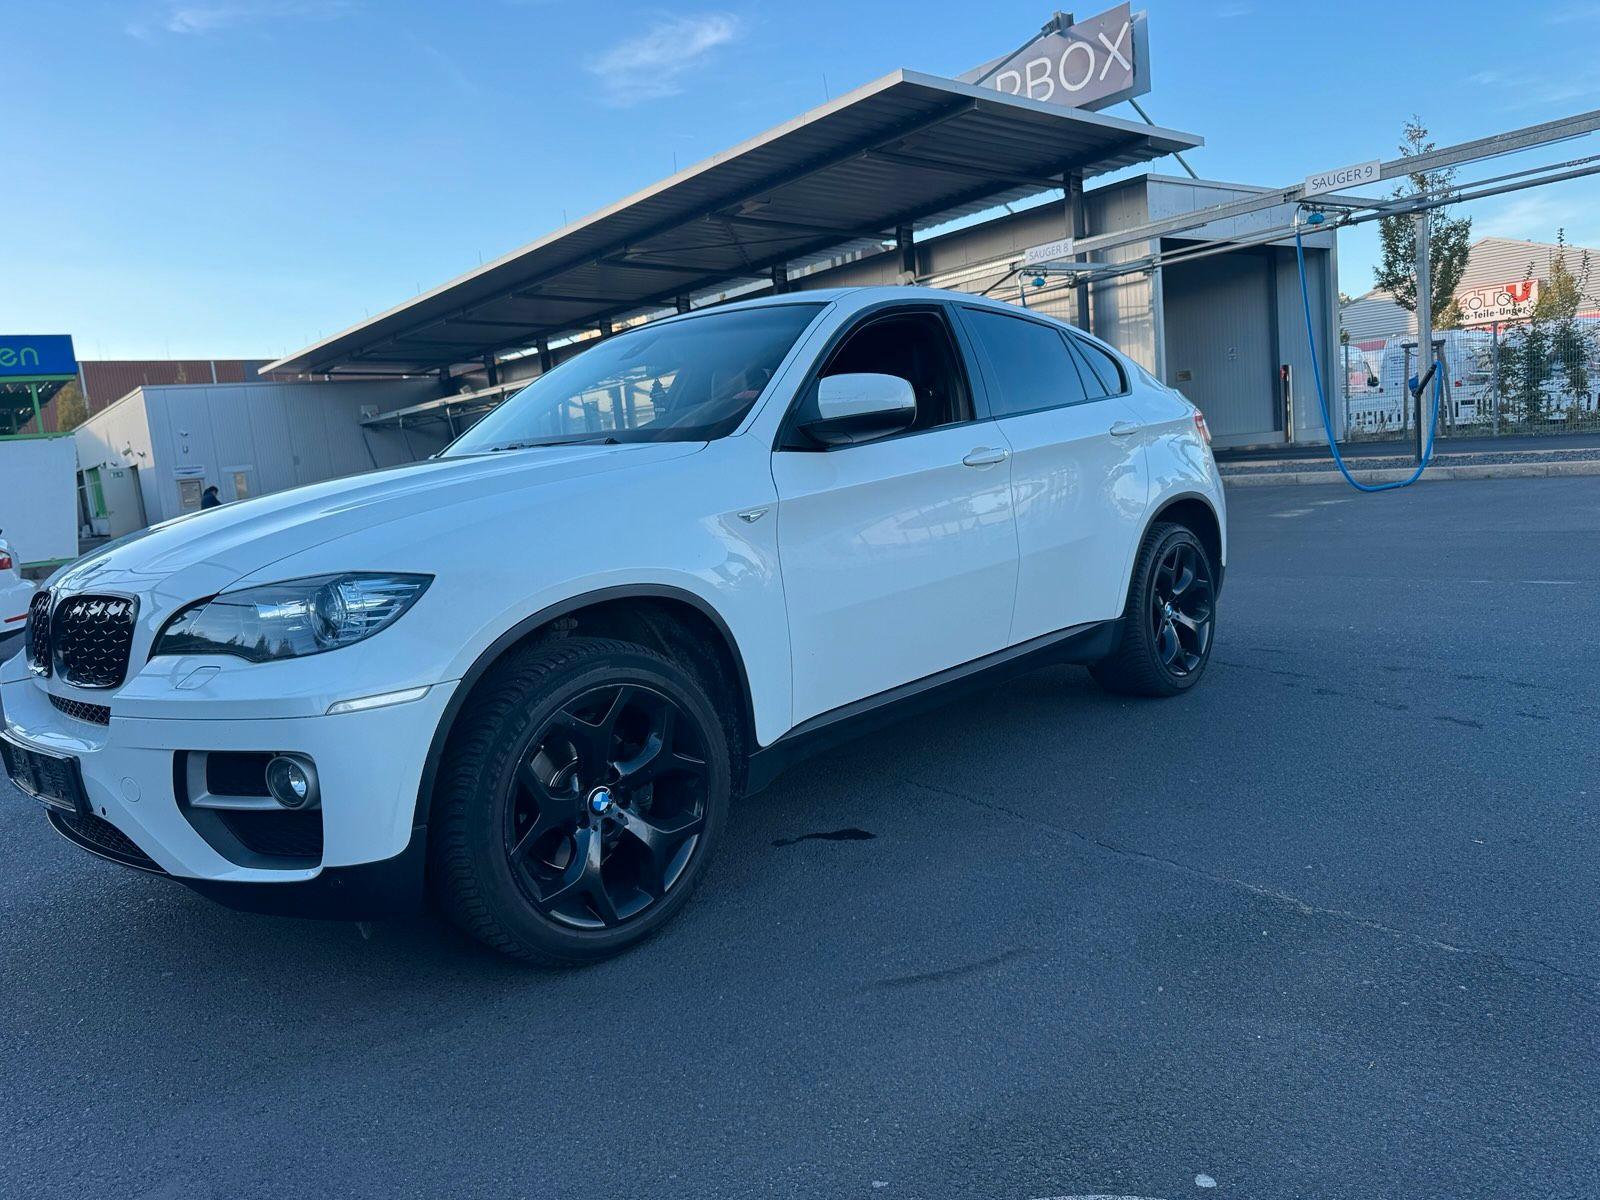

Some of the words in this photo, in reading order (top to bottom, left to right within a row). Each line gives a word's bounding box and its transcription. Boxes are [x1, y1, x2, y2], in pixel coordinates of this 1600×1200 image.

[1311, 168, 1361, 190] SAUGER
[1365, 165, 1373, 178] 9
[1029, 245, 1061, 260] SAUGER
[1063, 243, 1069, 252] 8
